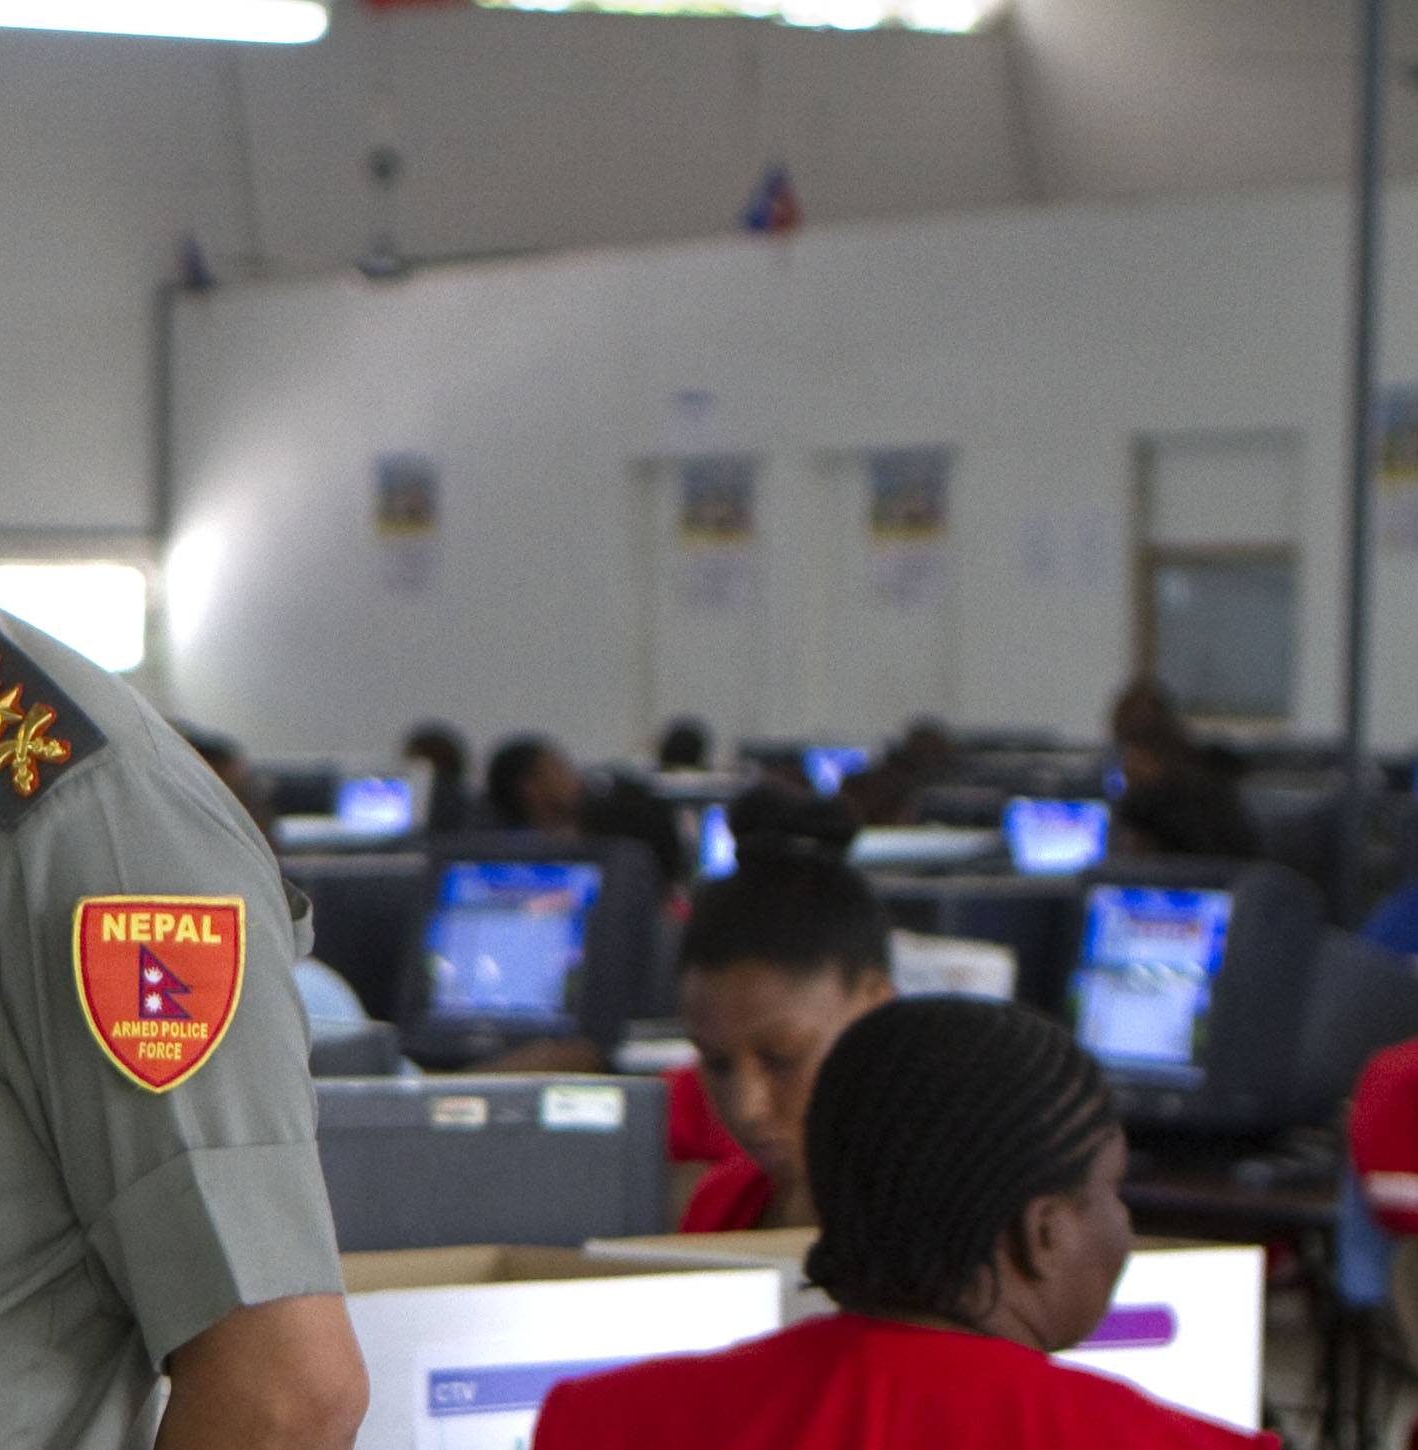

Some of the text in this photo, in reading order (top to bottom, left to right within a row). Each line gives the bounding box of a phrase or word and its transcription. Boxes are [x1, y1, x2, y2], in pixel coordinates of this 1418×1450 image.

[102, 913, 221, 943] NEPAL
[112, 1021, 208, 1039] ARMED POLICE
[138, 1042, 182, 1059] FORCE
